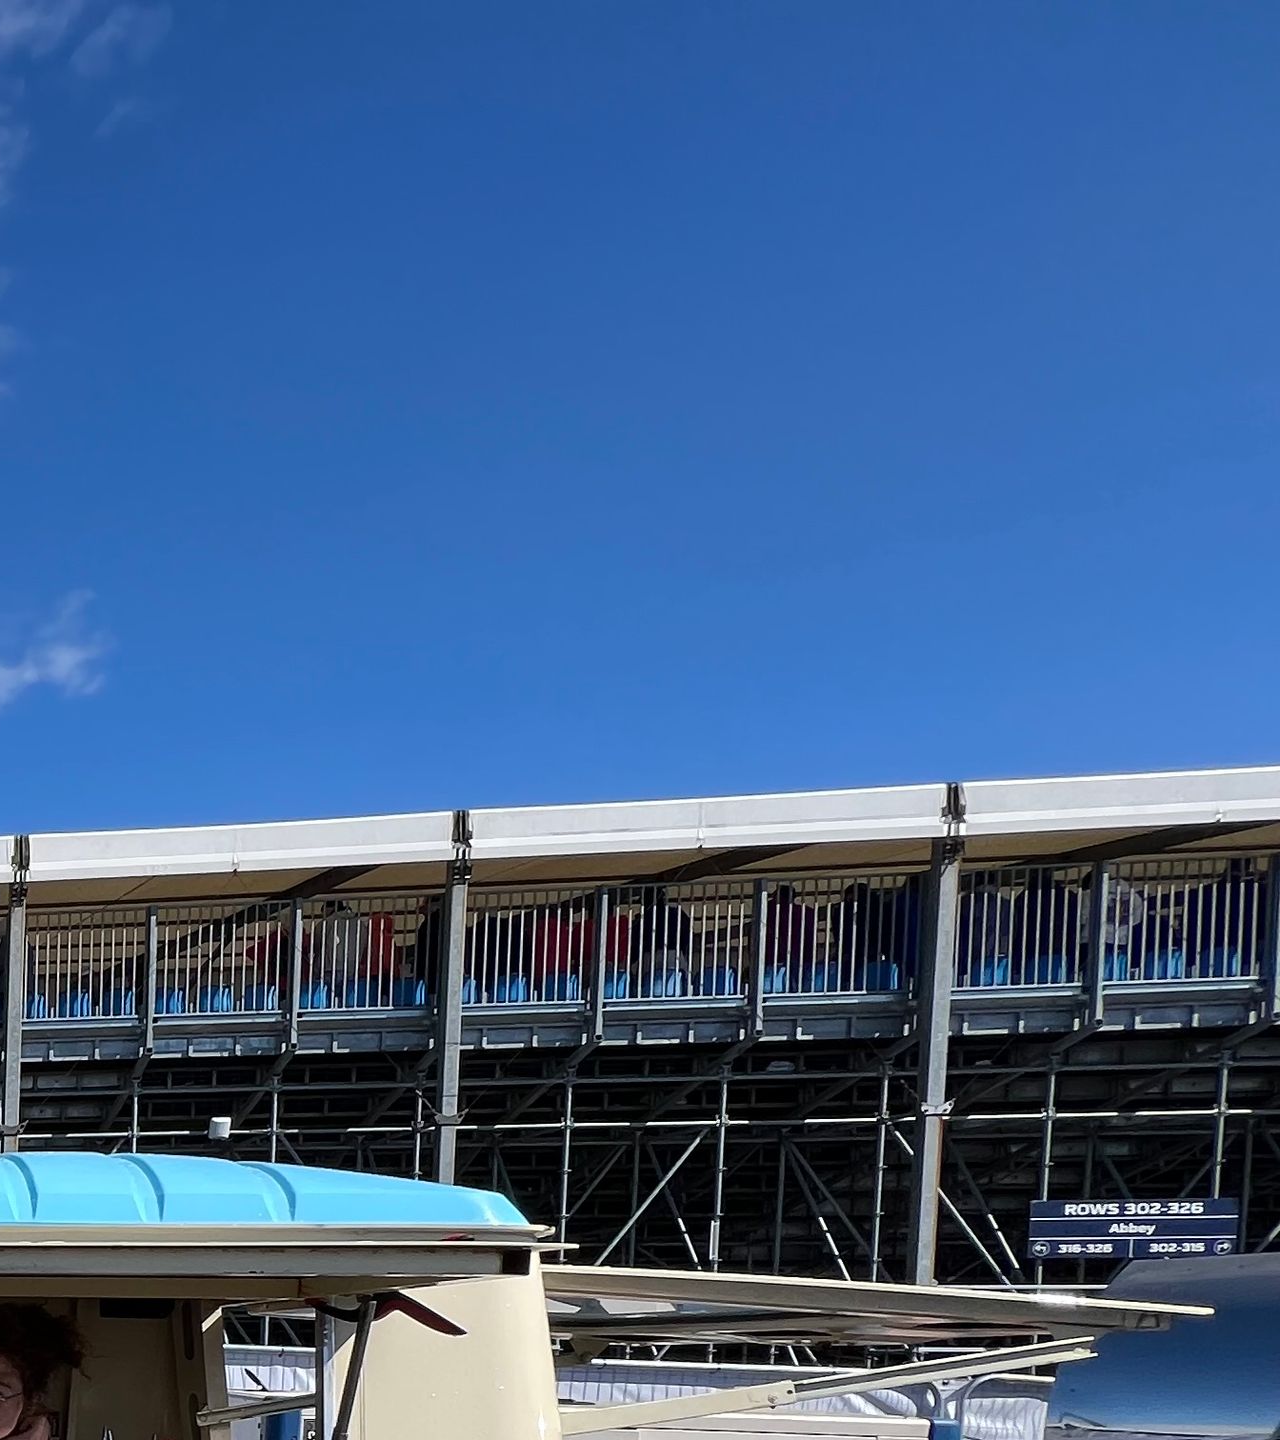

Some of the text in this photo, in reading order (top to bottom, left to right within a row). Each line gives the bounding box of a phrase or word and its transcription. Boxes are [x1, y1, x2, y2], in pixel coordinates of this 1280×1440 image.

[1063, 1202, 1204, 1216] ROWS 302-326
[1108, 1222, 1156, 1235] Abbey
[1149, 1242, 1205, 1254] 302-315
